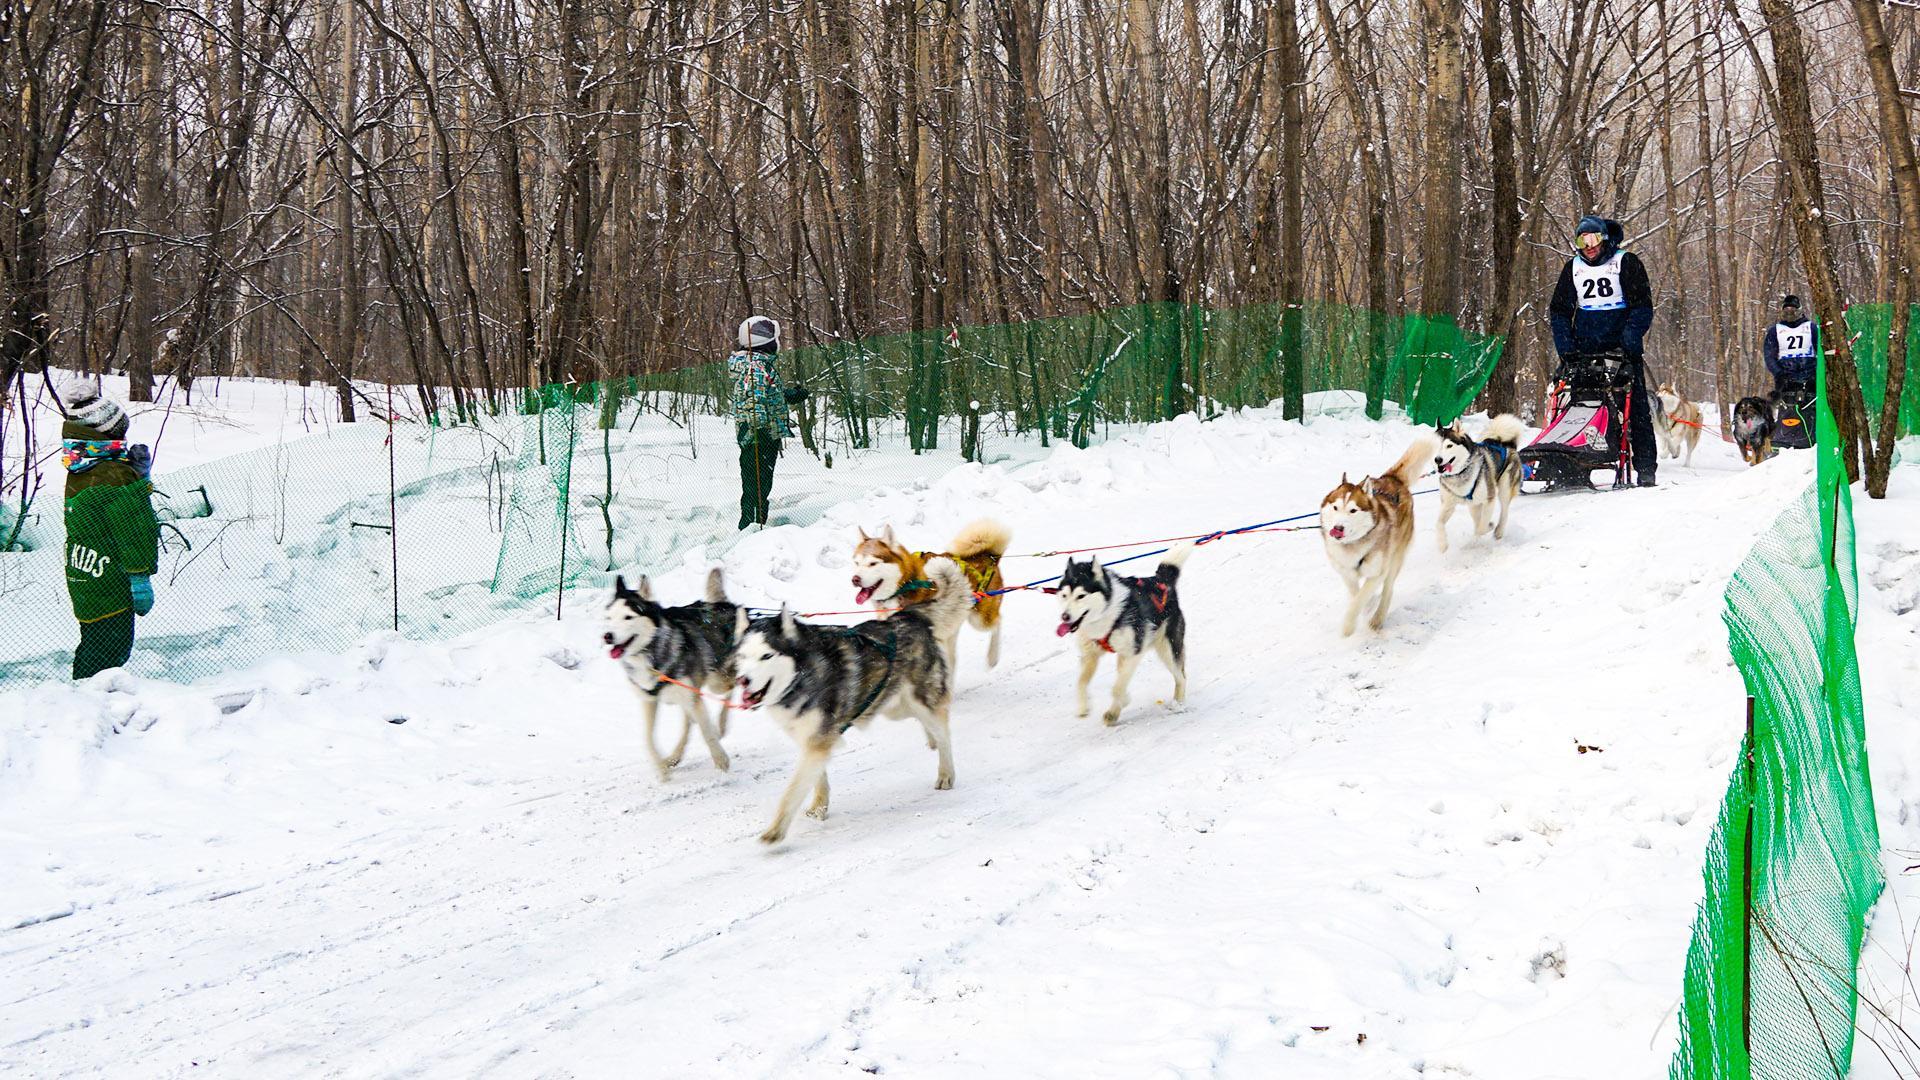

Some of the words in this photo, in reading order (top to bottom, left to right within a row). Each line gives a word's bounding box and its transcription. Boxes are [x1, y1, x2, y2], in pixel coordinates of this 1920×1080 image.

[1583, 277, 1613, 299] 28
[1786, 335, 1804, 350] 27
[71, 543, 111, 578] KIDS
